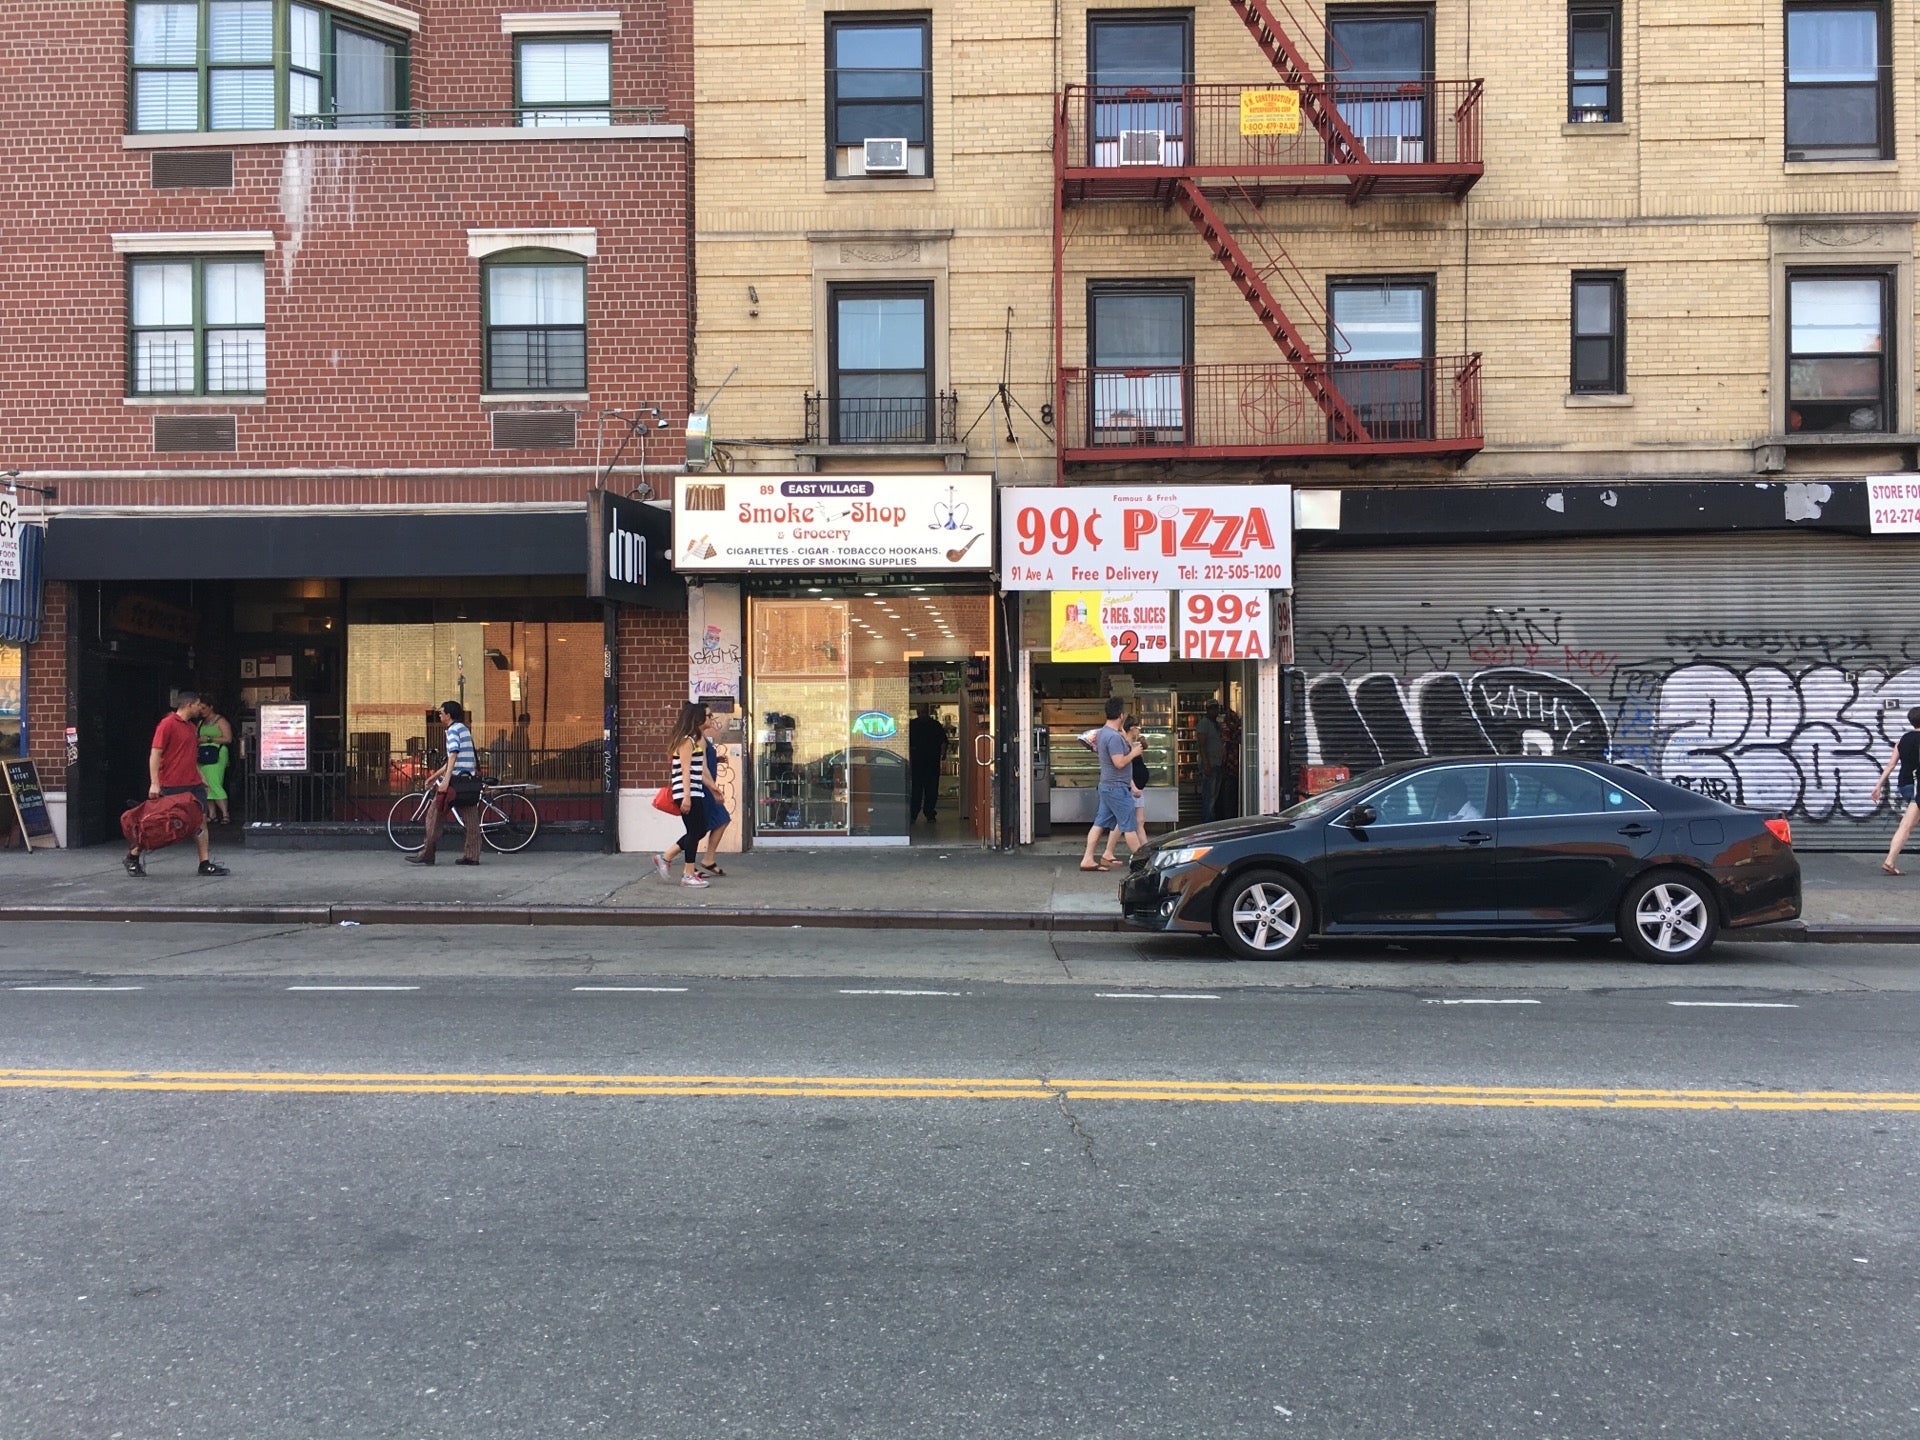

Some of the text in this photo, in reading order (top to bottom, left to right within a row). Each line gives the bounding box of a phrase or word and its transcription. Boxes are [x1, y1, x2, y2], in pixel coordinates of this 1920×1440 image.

[1255, 94, 1291, 105] CONSTRUCTION
[760, 484, 866, 495] 89 EAST VILLAGE
[1872, 485, 1903, 499] STORE
[1113, 493, 1177, 502] Famous & Fresh
[738, 502, 906, 527] Smoke Shop
[793, 528, 850, 541] Grocery
[1016, 506, 1104, 556] 99¢
[1, 541, 18, 550] JUICE
[726, 547, 789, 555] CIGARETTES
[797, 547, 829, 555] CIGAR
[838, 547, 886, 555] TOBACCO
[748, 558, 917, 566] ALL TYPES OF SMOKING SUPPLIES
[1011, 564, 1281, 584] 91 Ave A Free Delivery Tel: 212-505-1200
[1102, 606, 1166, 624] 2 REG. SLICES
[1187, 593, 1262, 625] 99¢
[1110, 629, 1167, 663] $2.75
[1184, 629, 1264, 659] PIZZA
[244, 661, 253, 673] B
[1480, 684, 1591, 751] KATHY
[852, 717, 895, 734] ATM
